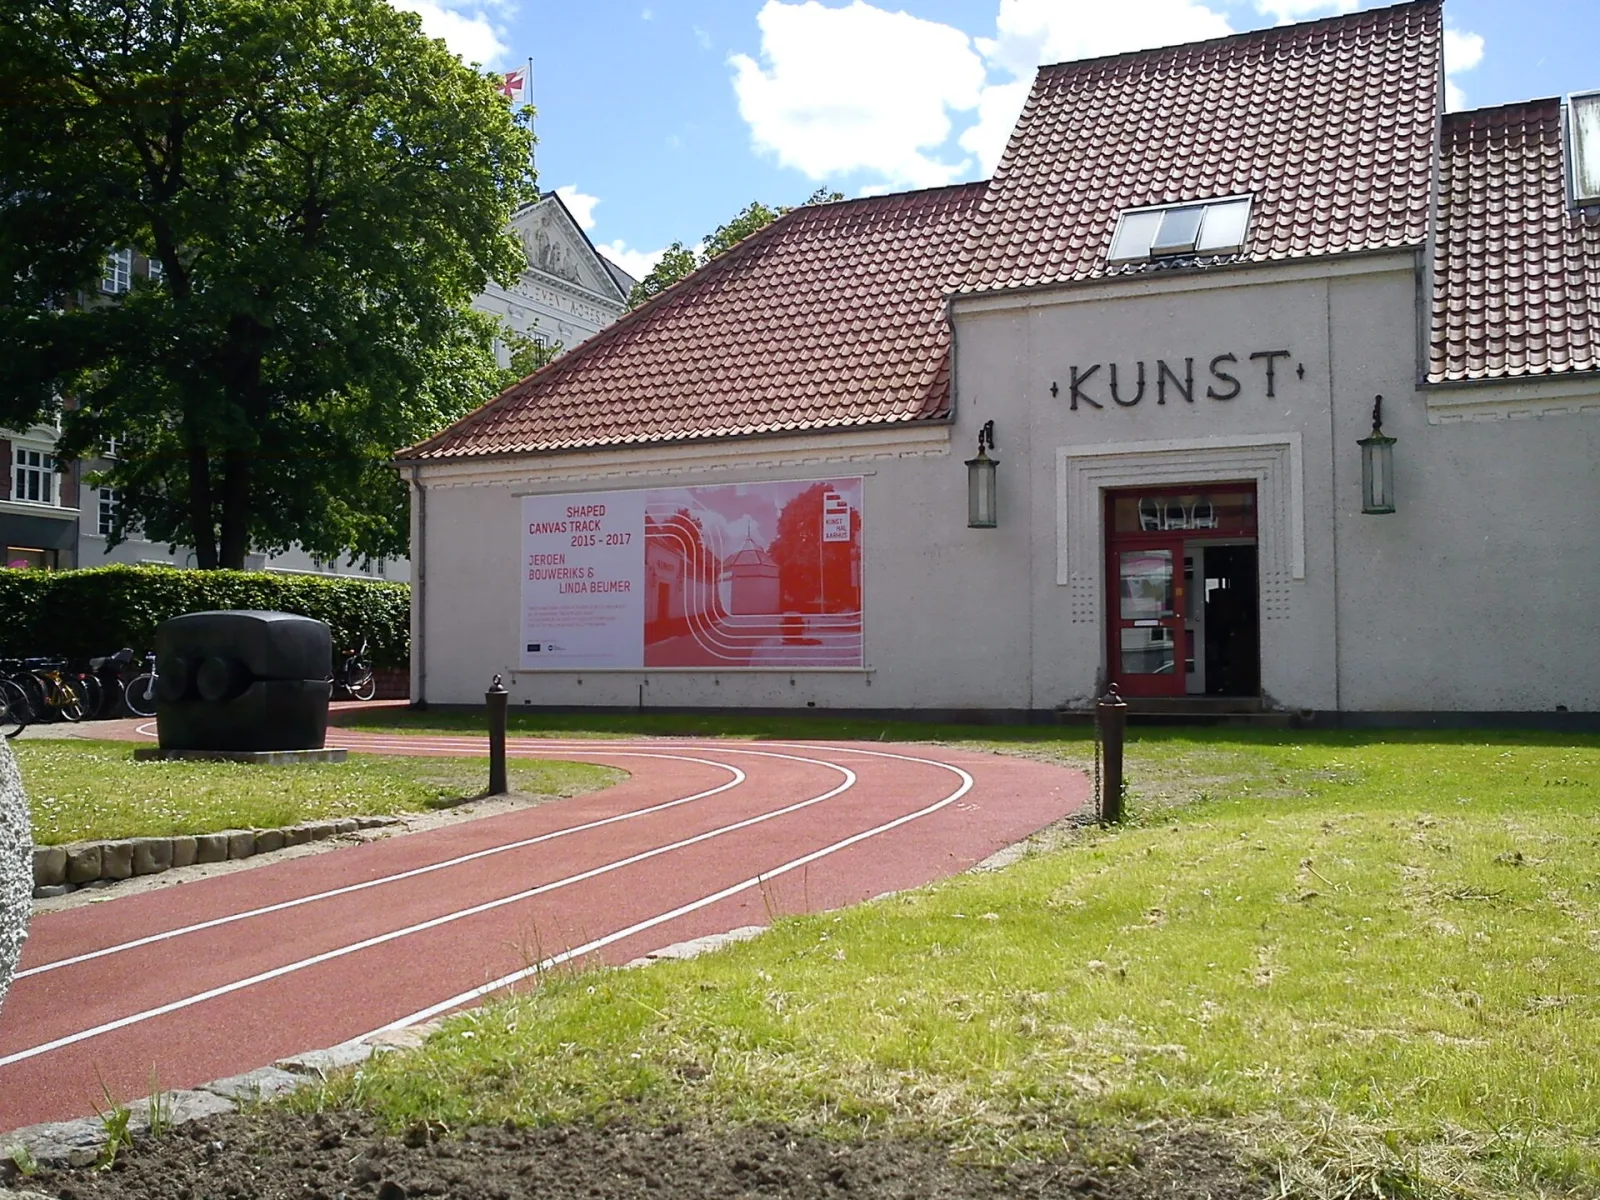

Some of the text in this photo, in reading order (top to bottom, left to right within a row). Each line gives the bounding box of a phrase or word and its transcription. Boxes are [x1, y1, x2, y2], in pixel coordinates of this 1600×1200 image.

[1070, 350, 1290, 410] KUNST
[567, 505, 605, 518] SHAPED
[529, 520, 601, 534] CANVAS TRACK
[571, 535, 596, 547] 2015
[606, 533, 631, 546] 2017
[529, 554, 565, 566] JEROEN
[528, 567, 594, 580] BOUWERIKS &
[559, 581, 631, 594] LINDA BEUMER
